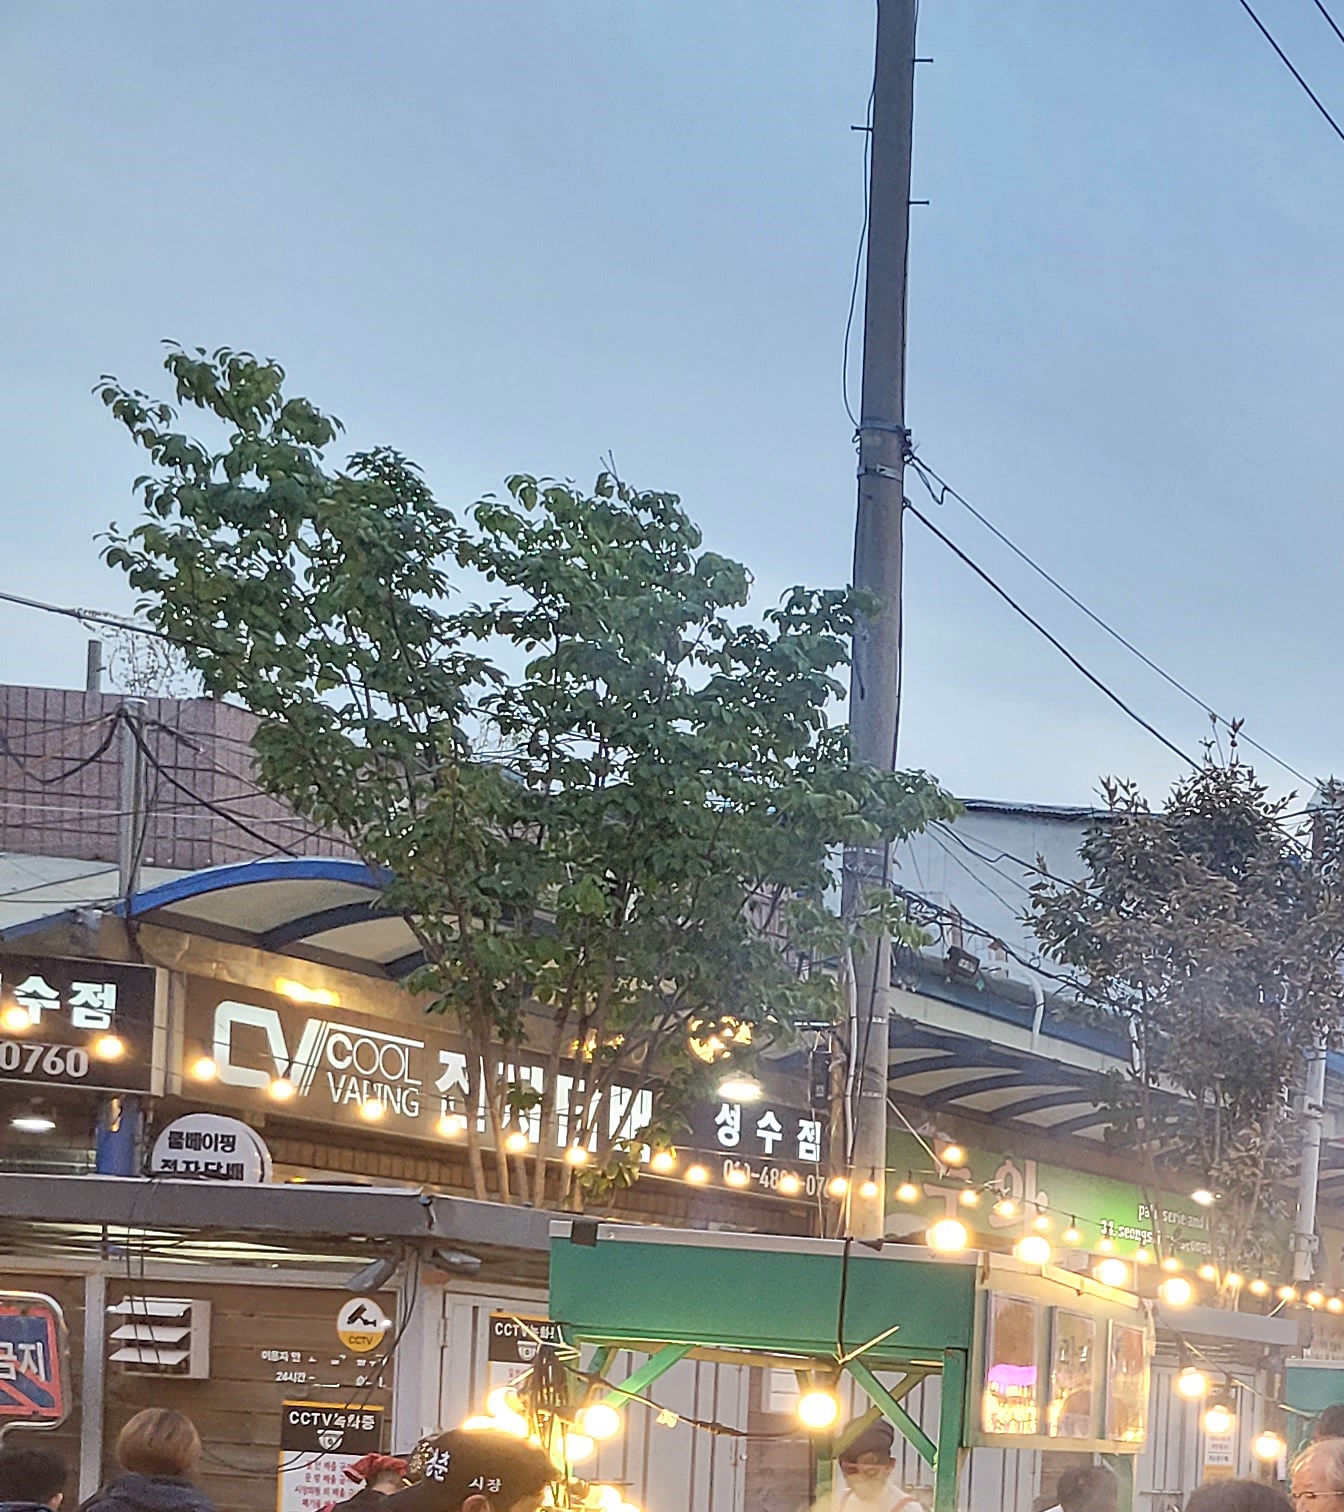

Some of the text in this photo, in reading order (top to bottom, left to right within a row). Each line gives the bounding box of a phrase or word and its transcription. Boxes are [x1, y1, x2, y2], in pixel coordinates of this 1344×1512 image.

[326, 1032, 422, 1085] COOL
[349, 1336, 374, 1345] CCTV
[467, 1475, 502, 1493] 시장
